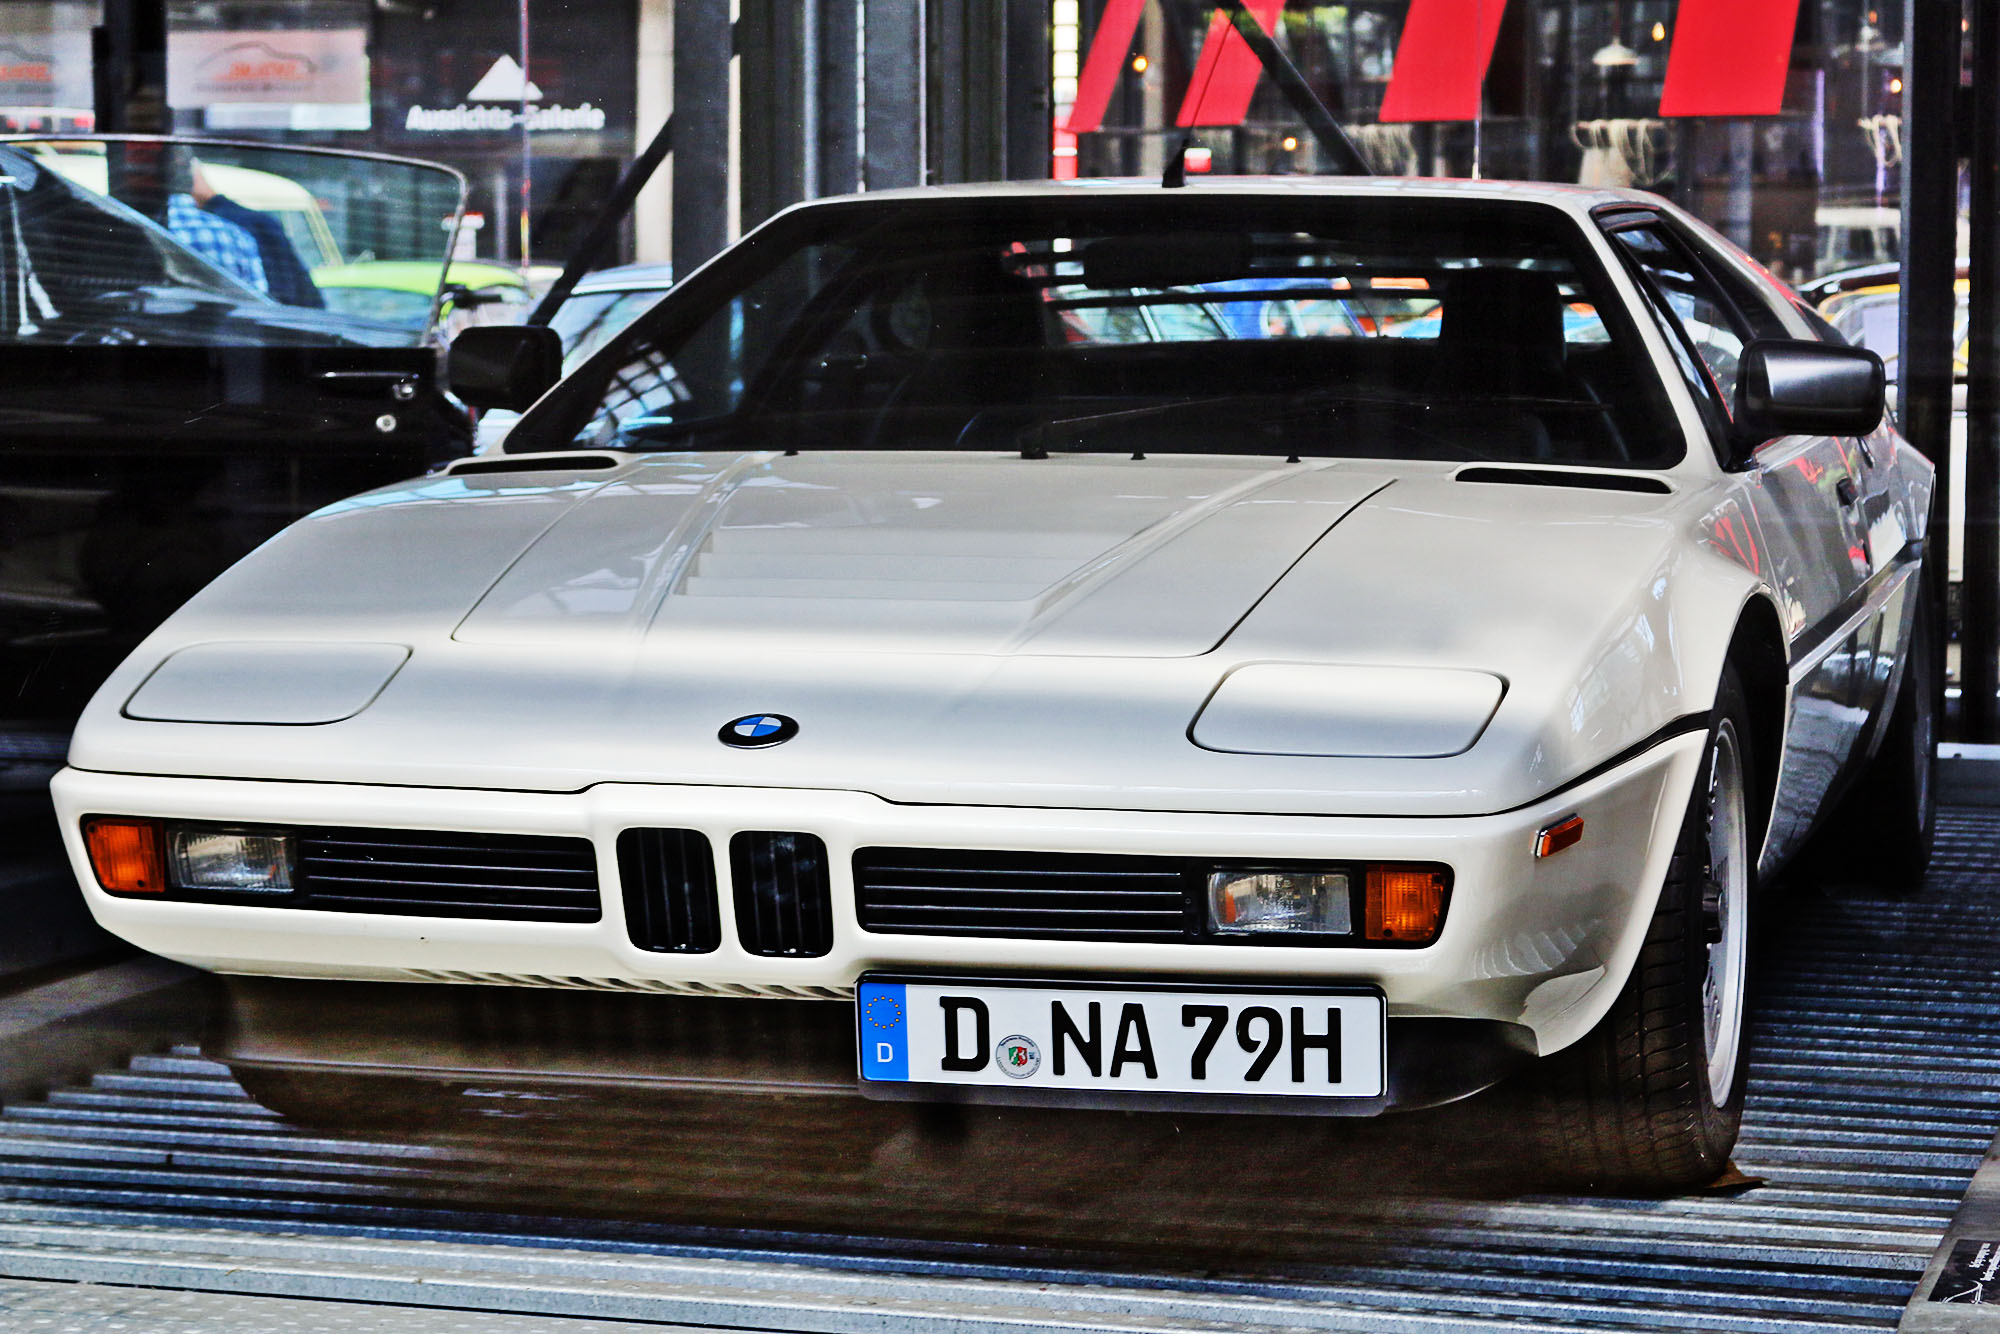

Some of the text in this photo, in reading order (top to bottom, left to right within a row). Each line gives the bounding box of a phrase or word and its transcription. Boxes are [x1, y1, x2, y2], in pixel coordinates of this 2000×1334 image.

[876, 1042, 894, 1063] D
[938, 996, 1342, 1084] D NA 79H
